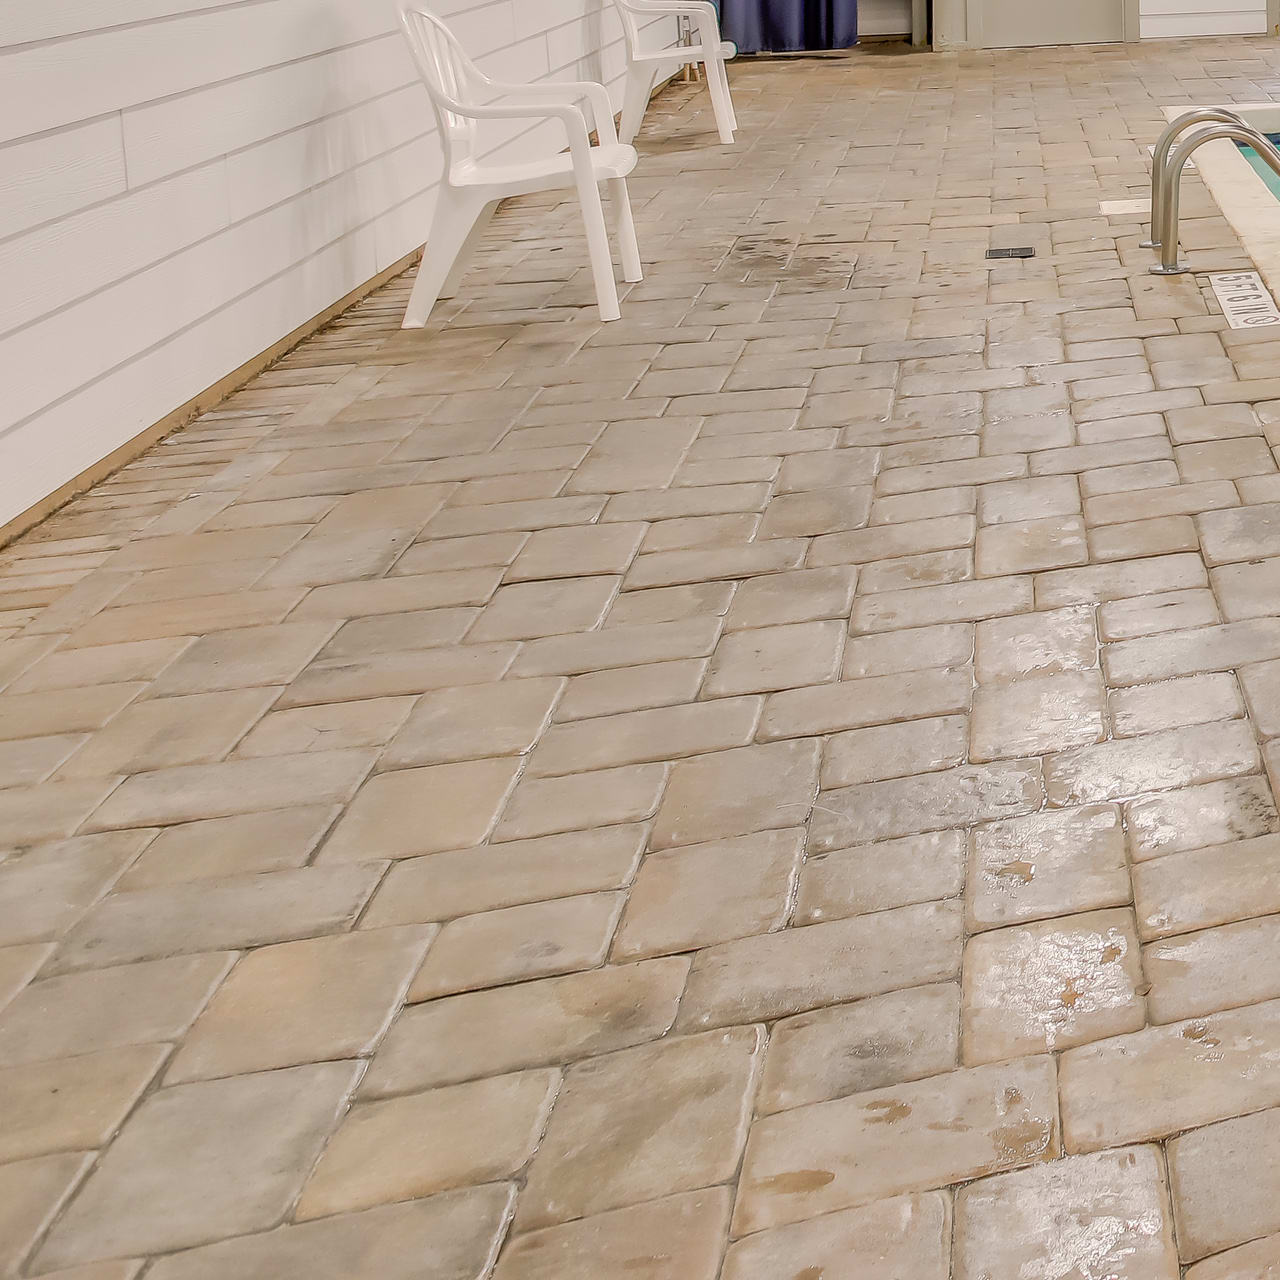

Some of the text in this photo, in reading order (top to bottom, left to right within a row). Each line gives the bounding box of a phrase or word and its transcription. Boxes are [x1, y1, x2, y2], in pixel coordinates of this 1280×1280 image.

[1216, 274, 1270, 316] 5 FT 6 IN
